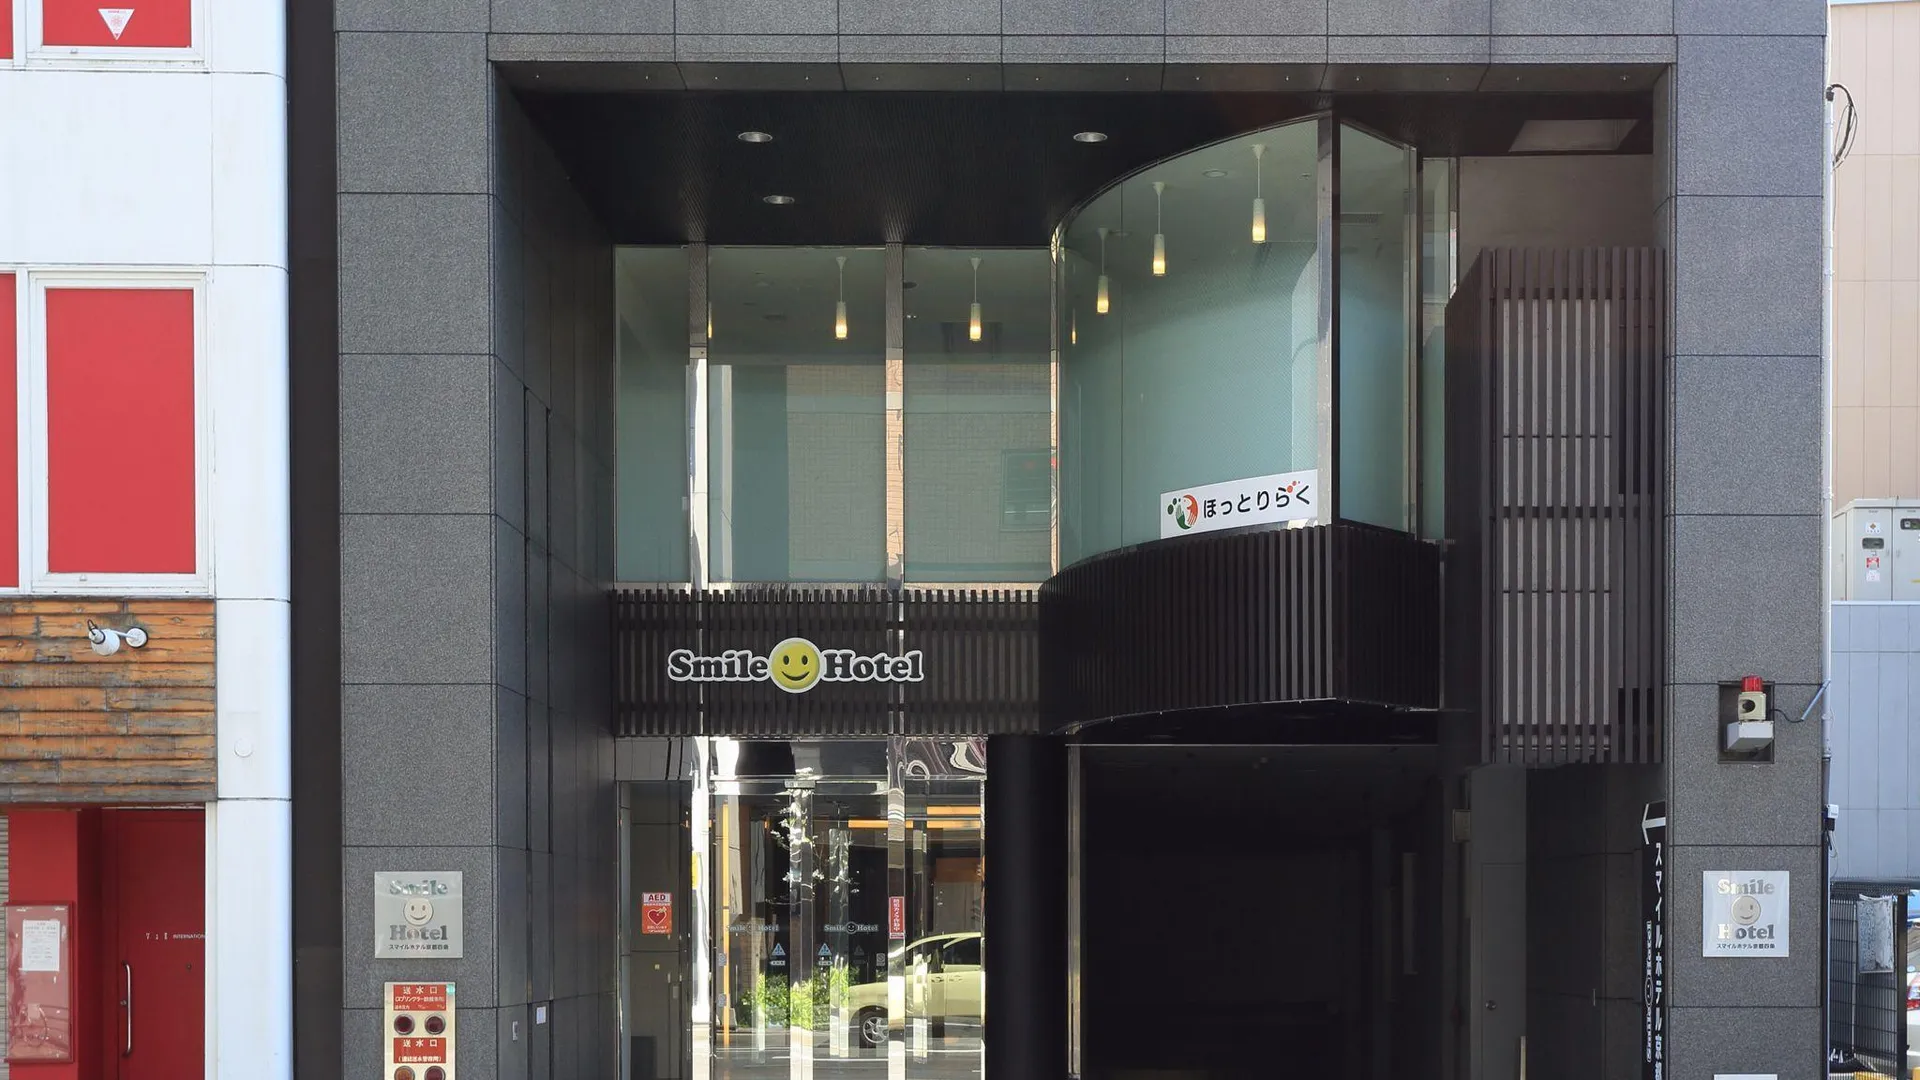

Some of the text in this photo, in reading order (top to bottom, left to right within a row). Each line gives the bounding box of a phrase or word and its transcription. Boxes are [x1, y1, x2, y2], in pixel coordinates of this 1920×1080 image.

[1203, 484, 1311, 519] ほっとりらく
[668, 649, 925, 682] Smile Hotel
[389, 879, 449, 895] Smile
[1717, 878, 1775, 895] Smile
[648, 893, 666, 901] AED
[389, 924, 449, 941] Hotel
[758, 924, 780, 932] Hotel
[824, 924, 879, 932] Smile Hotel
[1717, 923, 1775, 940] Hotel
[403, 986, 438, 994] 送水口
[403, 1039, 438, 1047] 送水口
